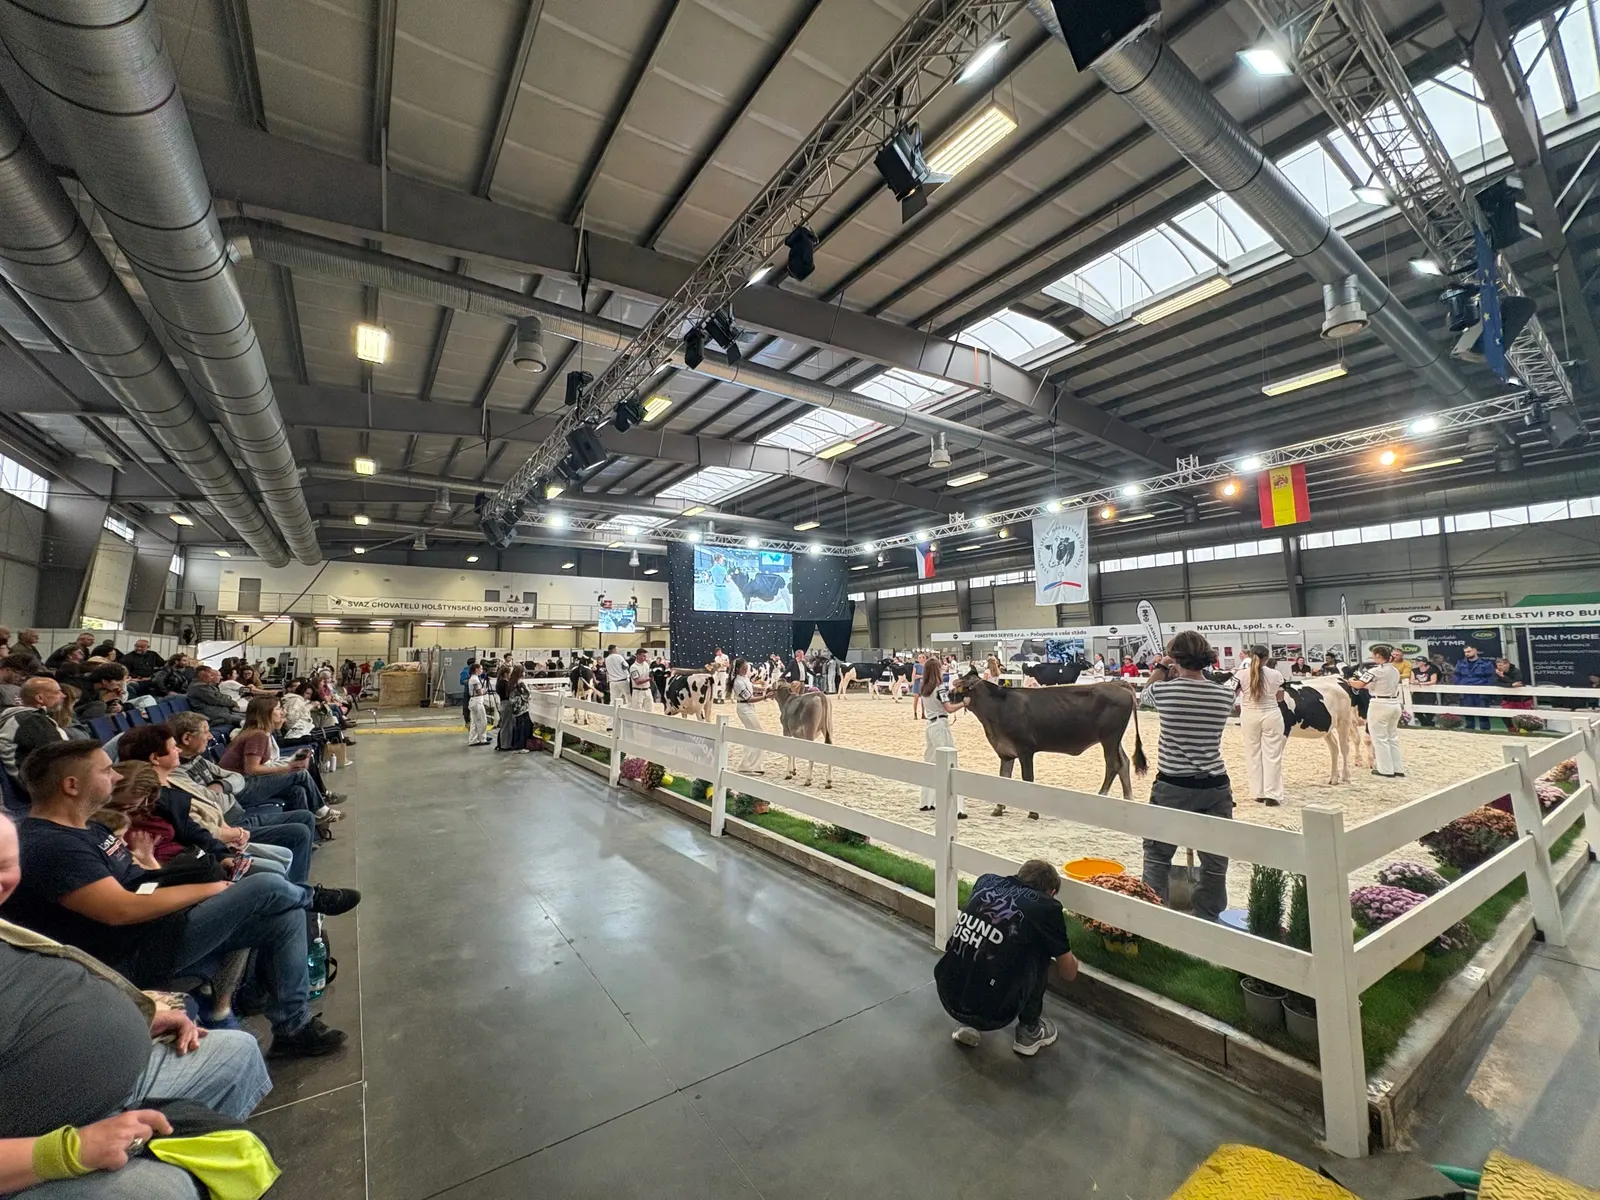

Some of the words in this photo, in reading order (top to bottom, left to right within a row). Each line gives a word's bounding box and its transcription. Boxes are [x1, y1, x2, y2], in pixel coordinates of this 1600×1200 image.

[347, 600, 370, 608] SVAZ
[421, 603, 482, 612] HOLŠTÝNSKÉHO
[484, 605, 507, 613] SKOTU
[508, 605, 519, 613] ČR
[1548, 610, 1575, 618] PRO
[1579, 609, 1600, 617] BU
[1196, 623, 1241, 631] NATURAL,
[1243, 622, 1265, 631] spol.
[1559, 633, 1600, 641] MORE
[957, 911, 1004, 945] OUND
[952, 924, 983, 949] USH
